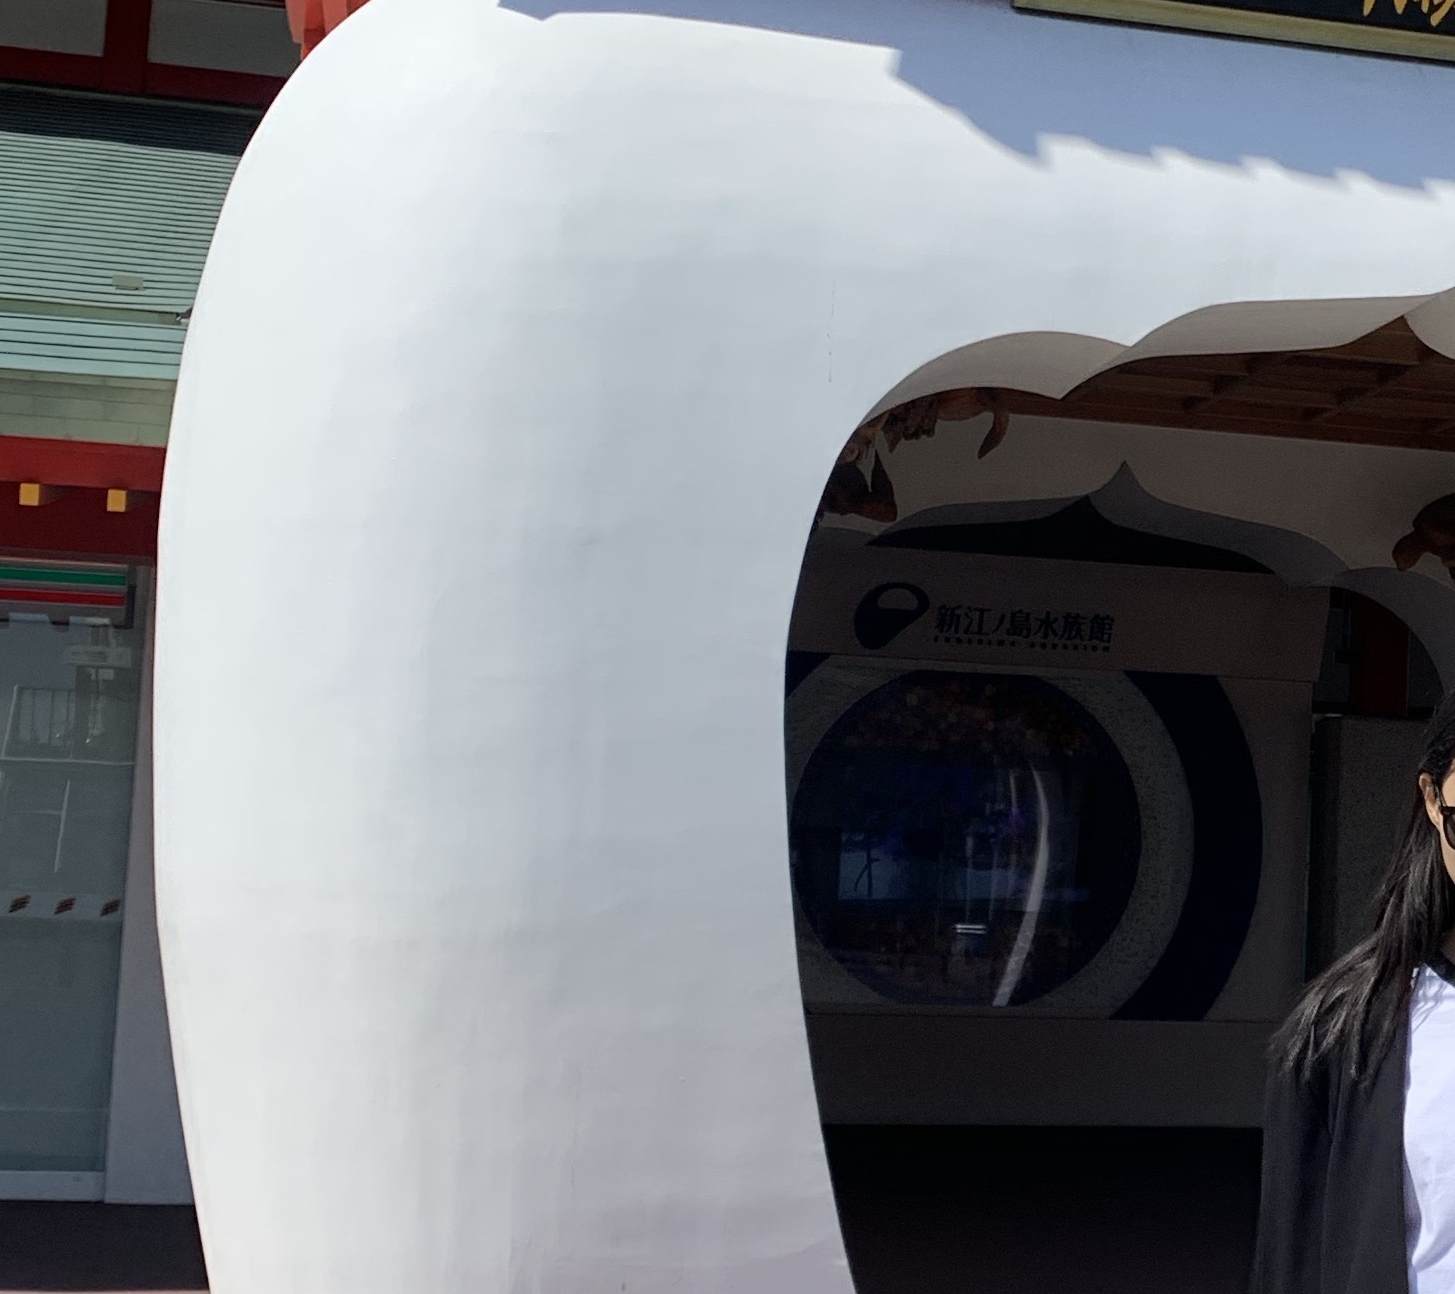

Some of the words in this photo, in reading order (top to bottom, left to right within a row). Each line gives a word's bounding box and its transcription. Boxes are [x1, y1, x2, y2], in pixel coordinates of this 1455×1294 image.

[935, 604, 1115, 644] 新江ノ島水族館
